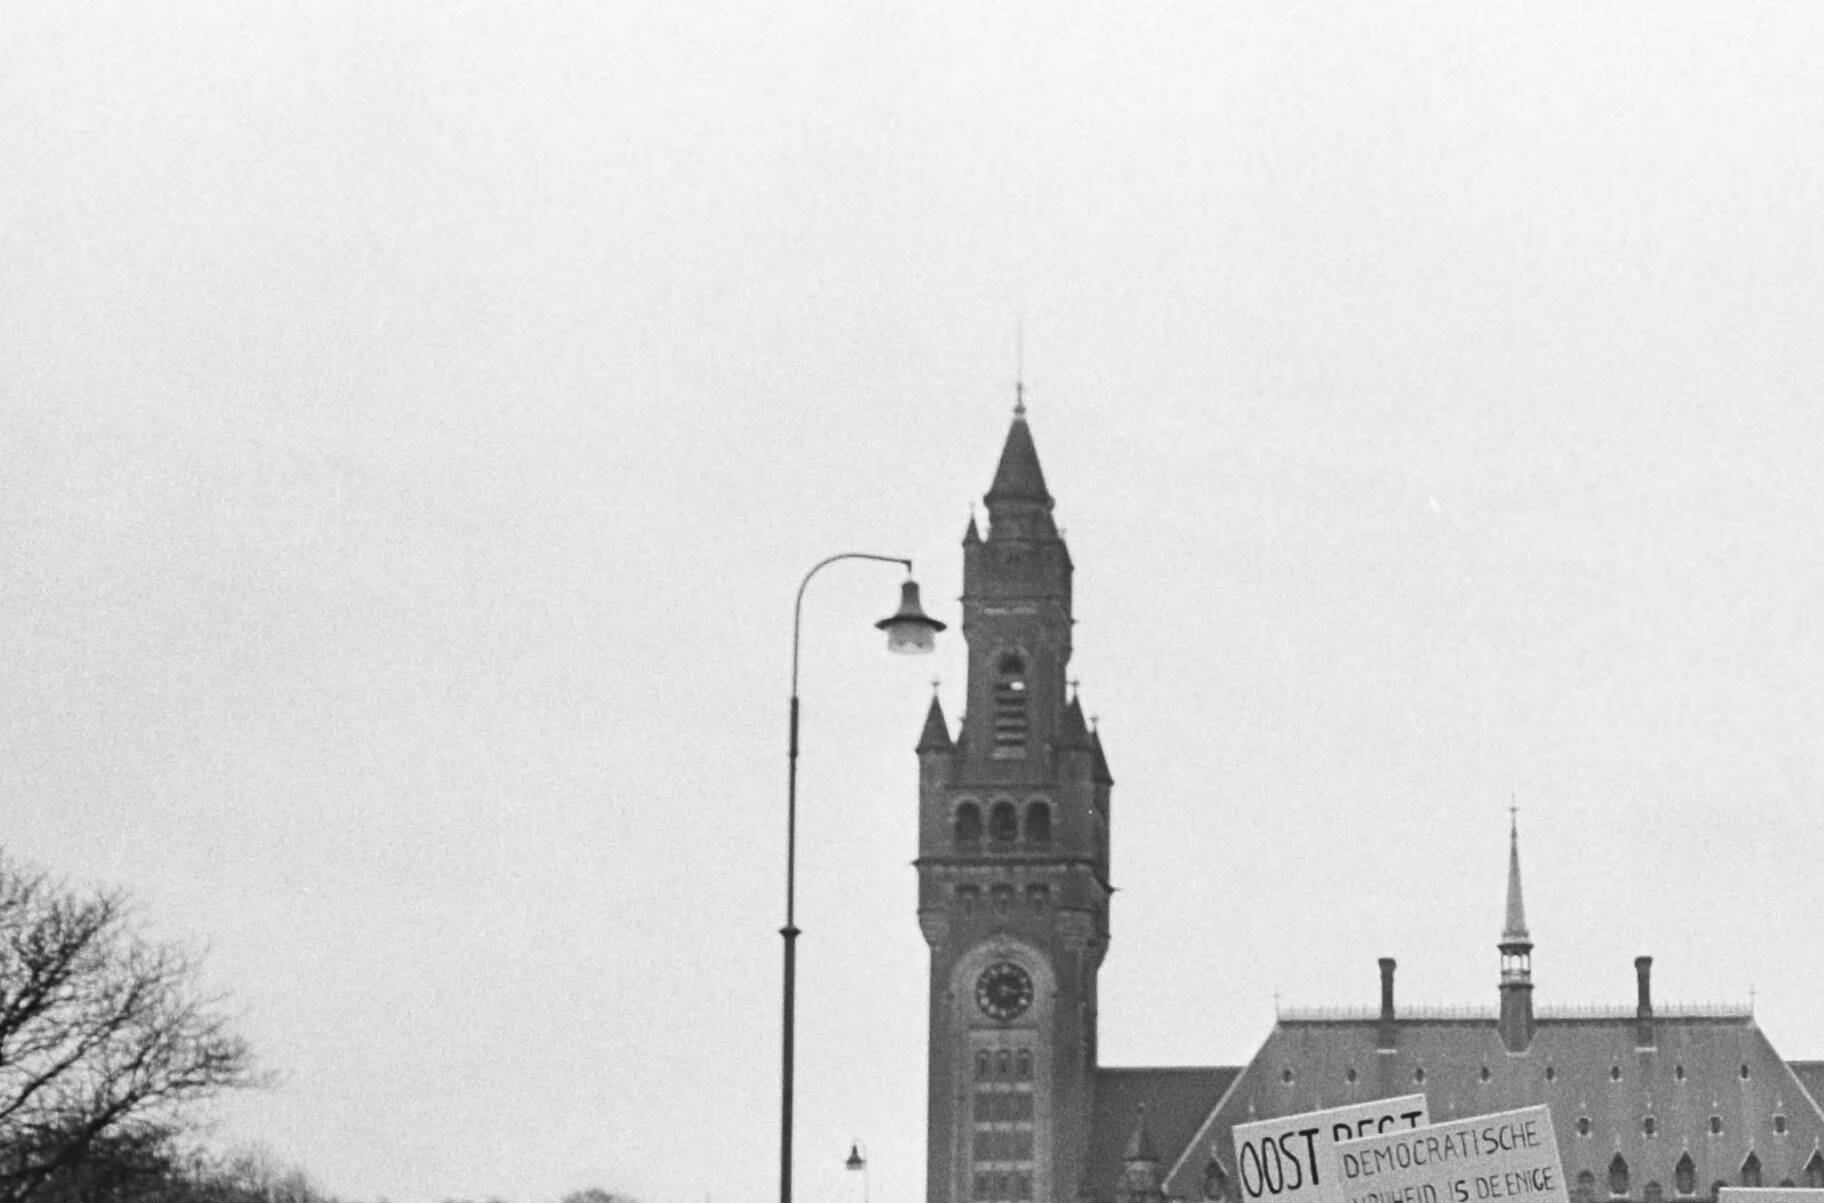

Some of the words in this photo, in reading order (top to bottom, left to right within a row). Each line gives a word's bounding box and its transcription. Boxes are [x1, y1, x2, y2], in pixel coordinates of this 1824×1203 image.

[1240, 1128, 1319, 1197] OOST
[1344, 1121, 1540, 1178] DEMOCRATISCHE
[1447, 1180, 1469, 1202] IS
[1477, 1175, 1501, 1198] DE
[1506, 1167, 1555, 1195] ENIGE
